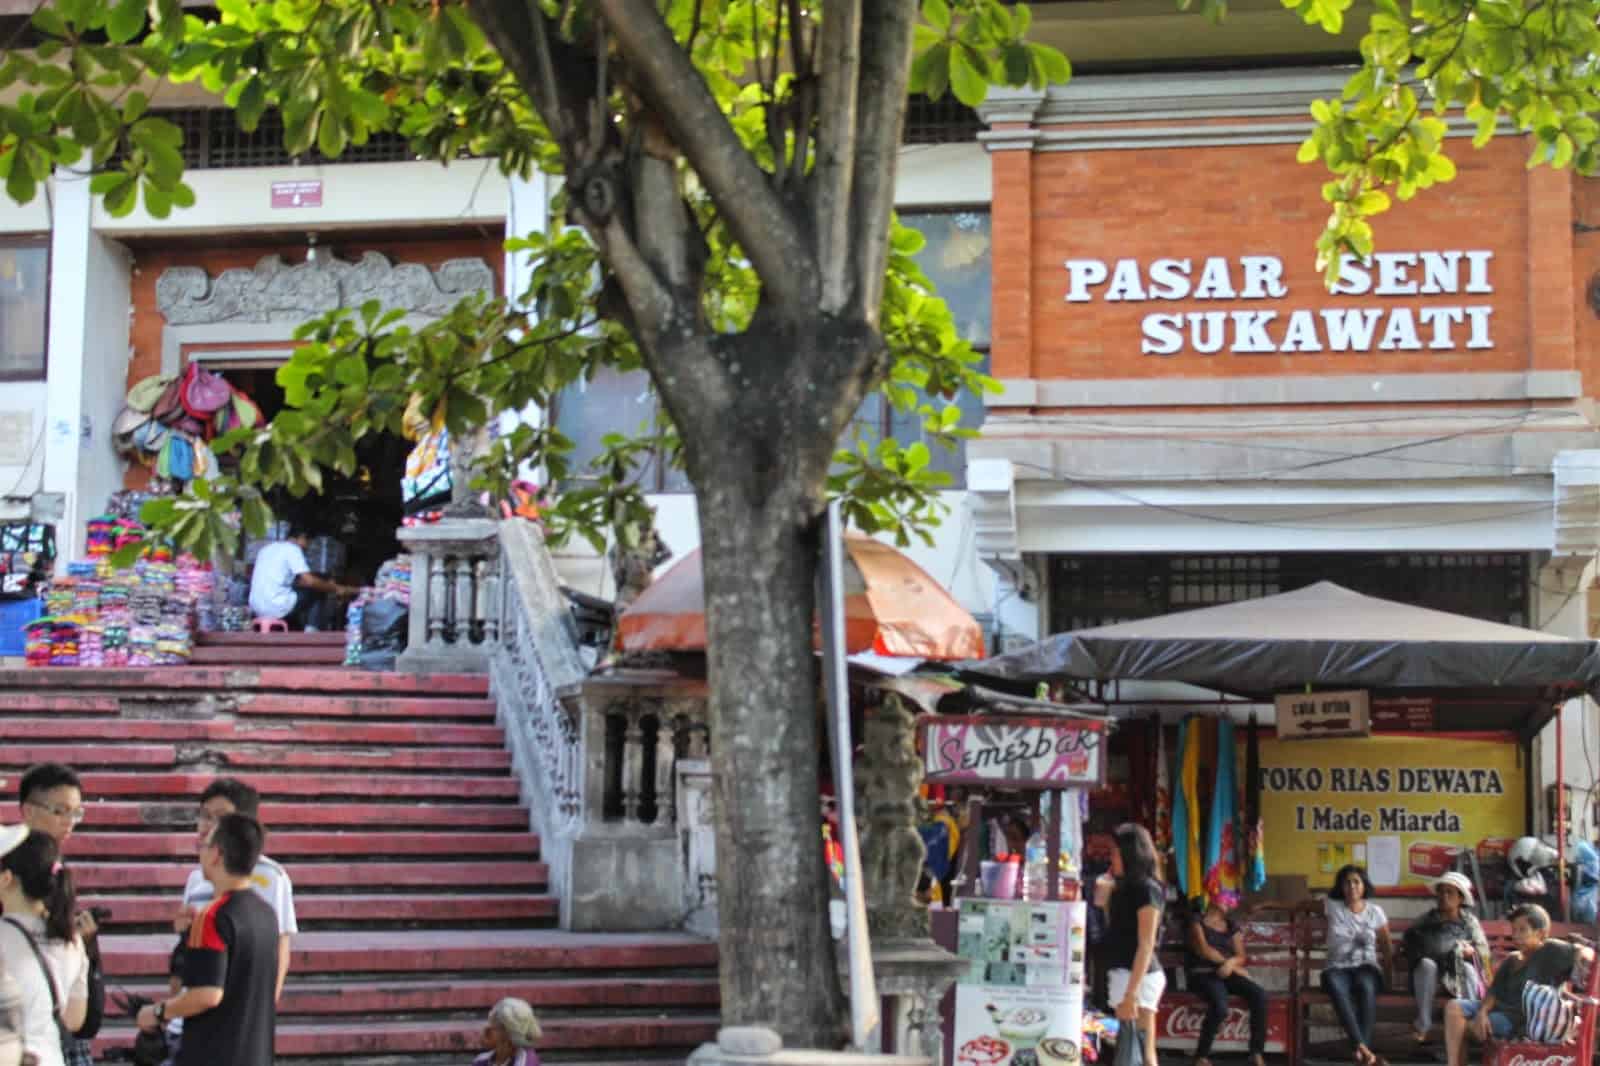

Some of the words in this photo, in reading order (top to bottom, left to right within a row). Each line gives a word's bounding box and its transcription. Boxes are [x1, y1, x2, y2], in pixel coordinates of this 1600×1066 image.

[1065, 256, 1287, 302] PASAR
[1329, 251, 1494, 296] SENI
[1141, 306, 1494, 355] SUKAWATI
[1259, 768, 1322, 791] TOKO
[1330, 769, 1390, 793] RIAS
[1398, 769, 1502, 793] DEWATA
[1296, 807, 1305, 830] I
[1313, 807, 1372, 831] Made
[1379, 808, 1460, 832] Miarda
[1166, 1006, 1251, 1038] Cocaola
